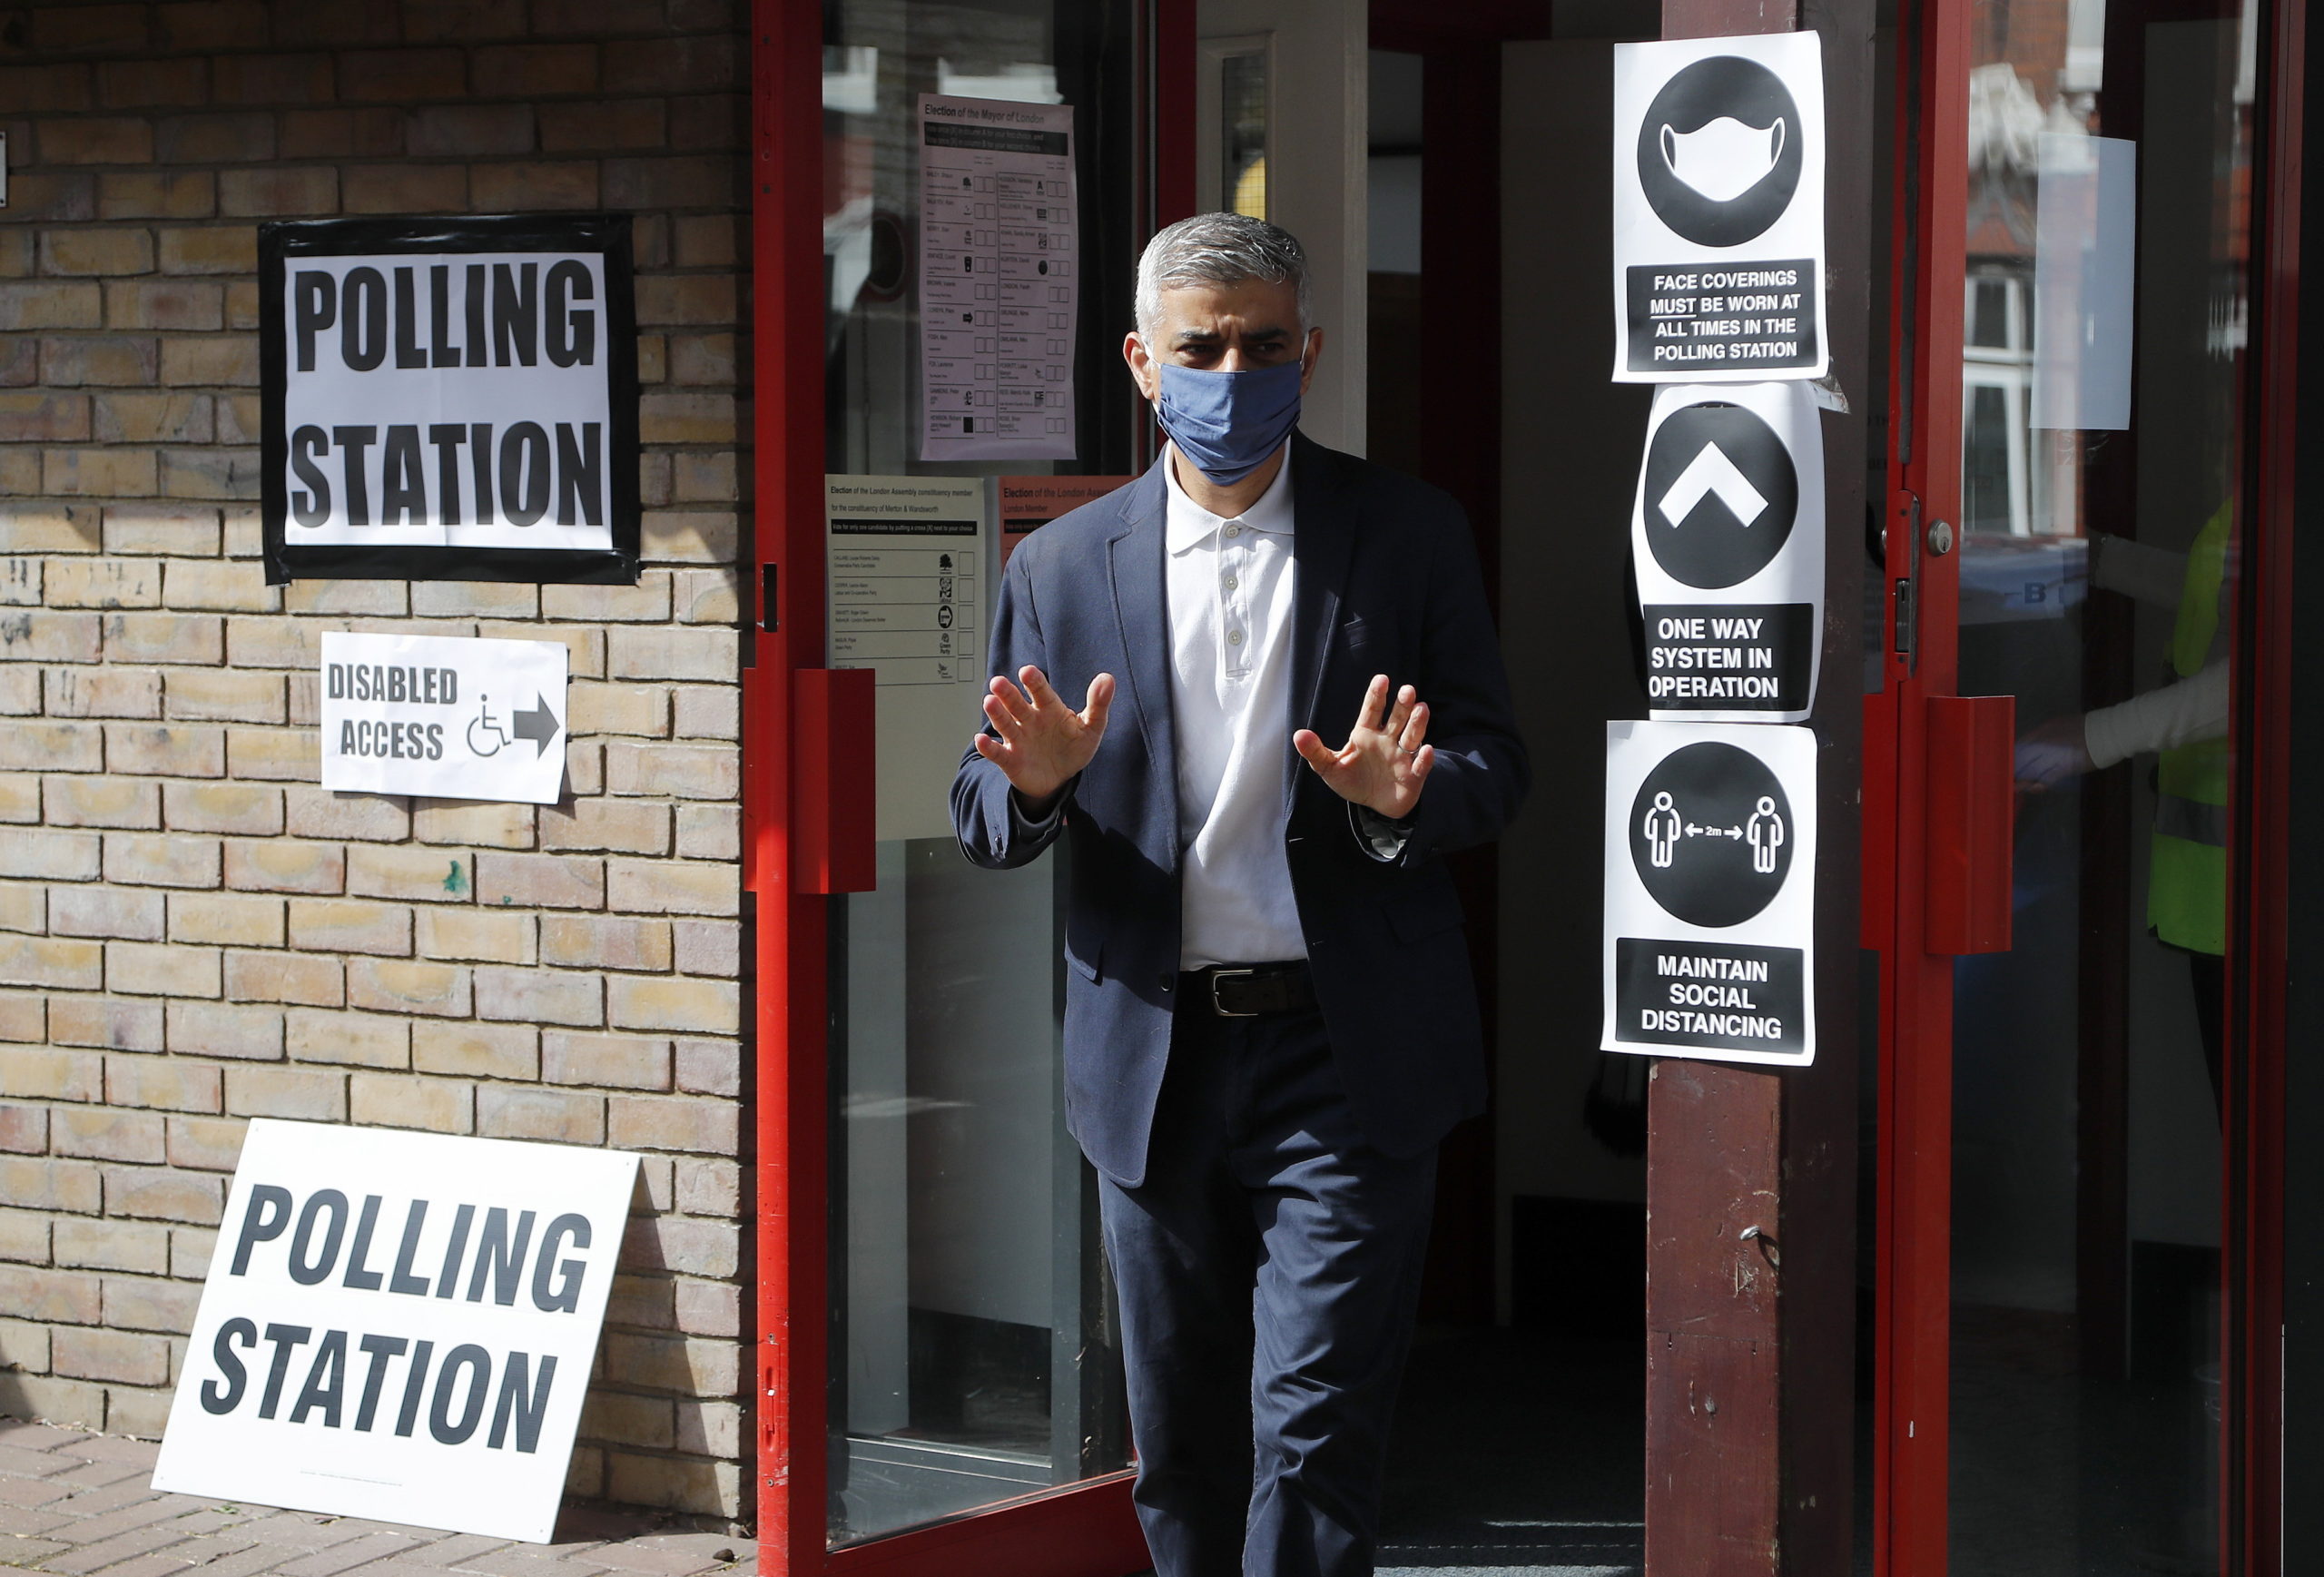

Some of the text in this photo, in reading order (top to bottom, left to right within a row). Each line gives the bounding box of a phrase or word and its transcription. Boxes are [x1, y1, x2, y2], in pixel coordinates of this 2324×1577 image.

[925, 104, 1044, 123] Election of the Mayor of London
[1654, 270, 1797, 291] FACE COVERINGS
[1649, 293, 1801, 315] MUST BE WORN AT
[295, 259, 596, 372] POLLING
[1655, 318, 1797, 338] ALL TIMES IN THE
[1654, 341, 1797, 360] POLLING STATION
[290, 420, 603, 527] STATION
[831, 486, 852, 494] Election
[891, 488, 917, 497] Assembly
[918, 489, 950, 498] constituency
[1004, 488, 1033, 498] Election
[1035, 488, 1042, 498] of
[1043, 488, 1055, 498] the
[1057, 488, 1085, 498] London
[848, 505, 878, 513] constituency
[885, 505, 902, 513] Merton
[903, 505, 908, 513] &
[909, 505, 939, 513] Wandsworth
[1004, 505, 1048, 513] London Member
[1658, 617, 1764, 639] ONE WAY
[1650, 646, 1773, 669] SYSTEM IN
[329, 663, 458, 705] DISABLED
[1649, 675, 1779, 698] OPERATION
[340, 719, 444, 761] ACCESS
[1706, 825, 1722, 837] 2m
[1657, 955, 1768, 982] MAINTAIN
[1669, 984, 1757, 1010] SOCIAL
[1640, 1010, 1783, 1040] DISTANCING
[230, 1183, 592, 1314] POLLING
[201, 1316, 558, 1454] STATION
